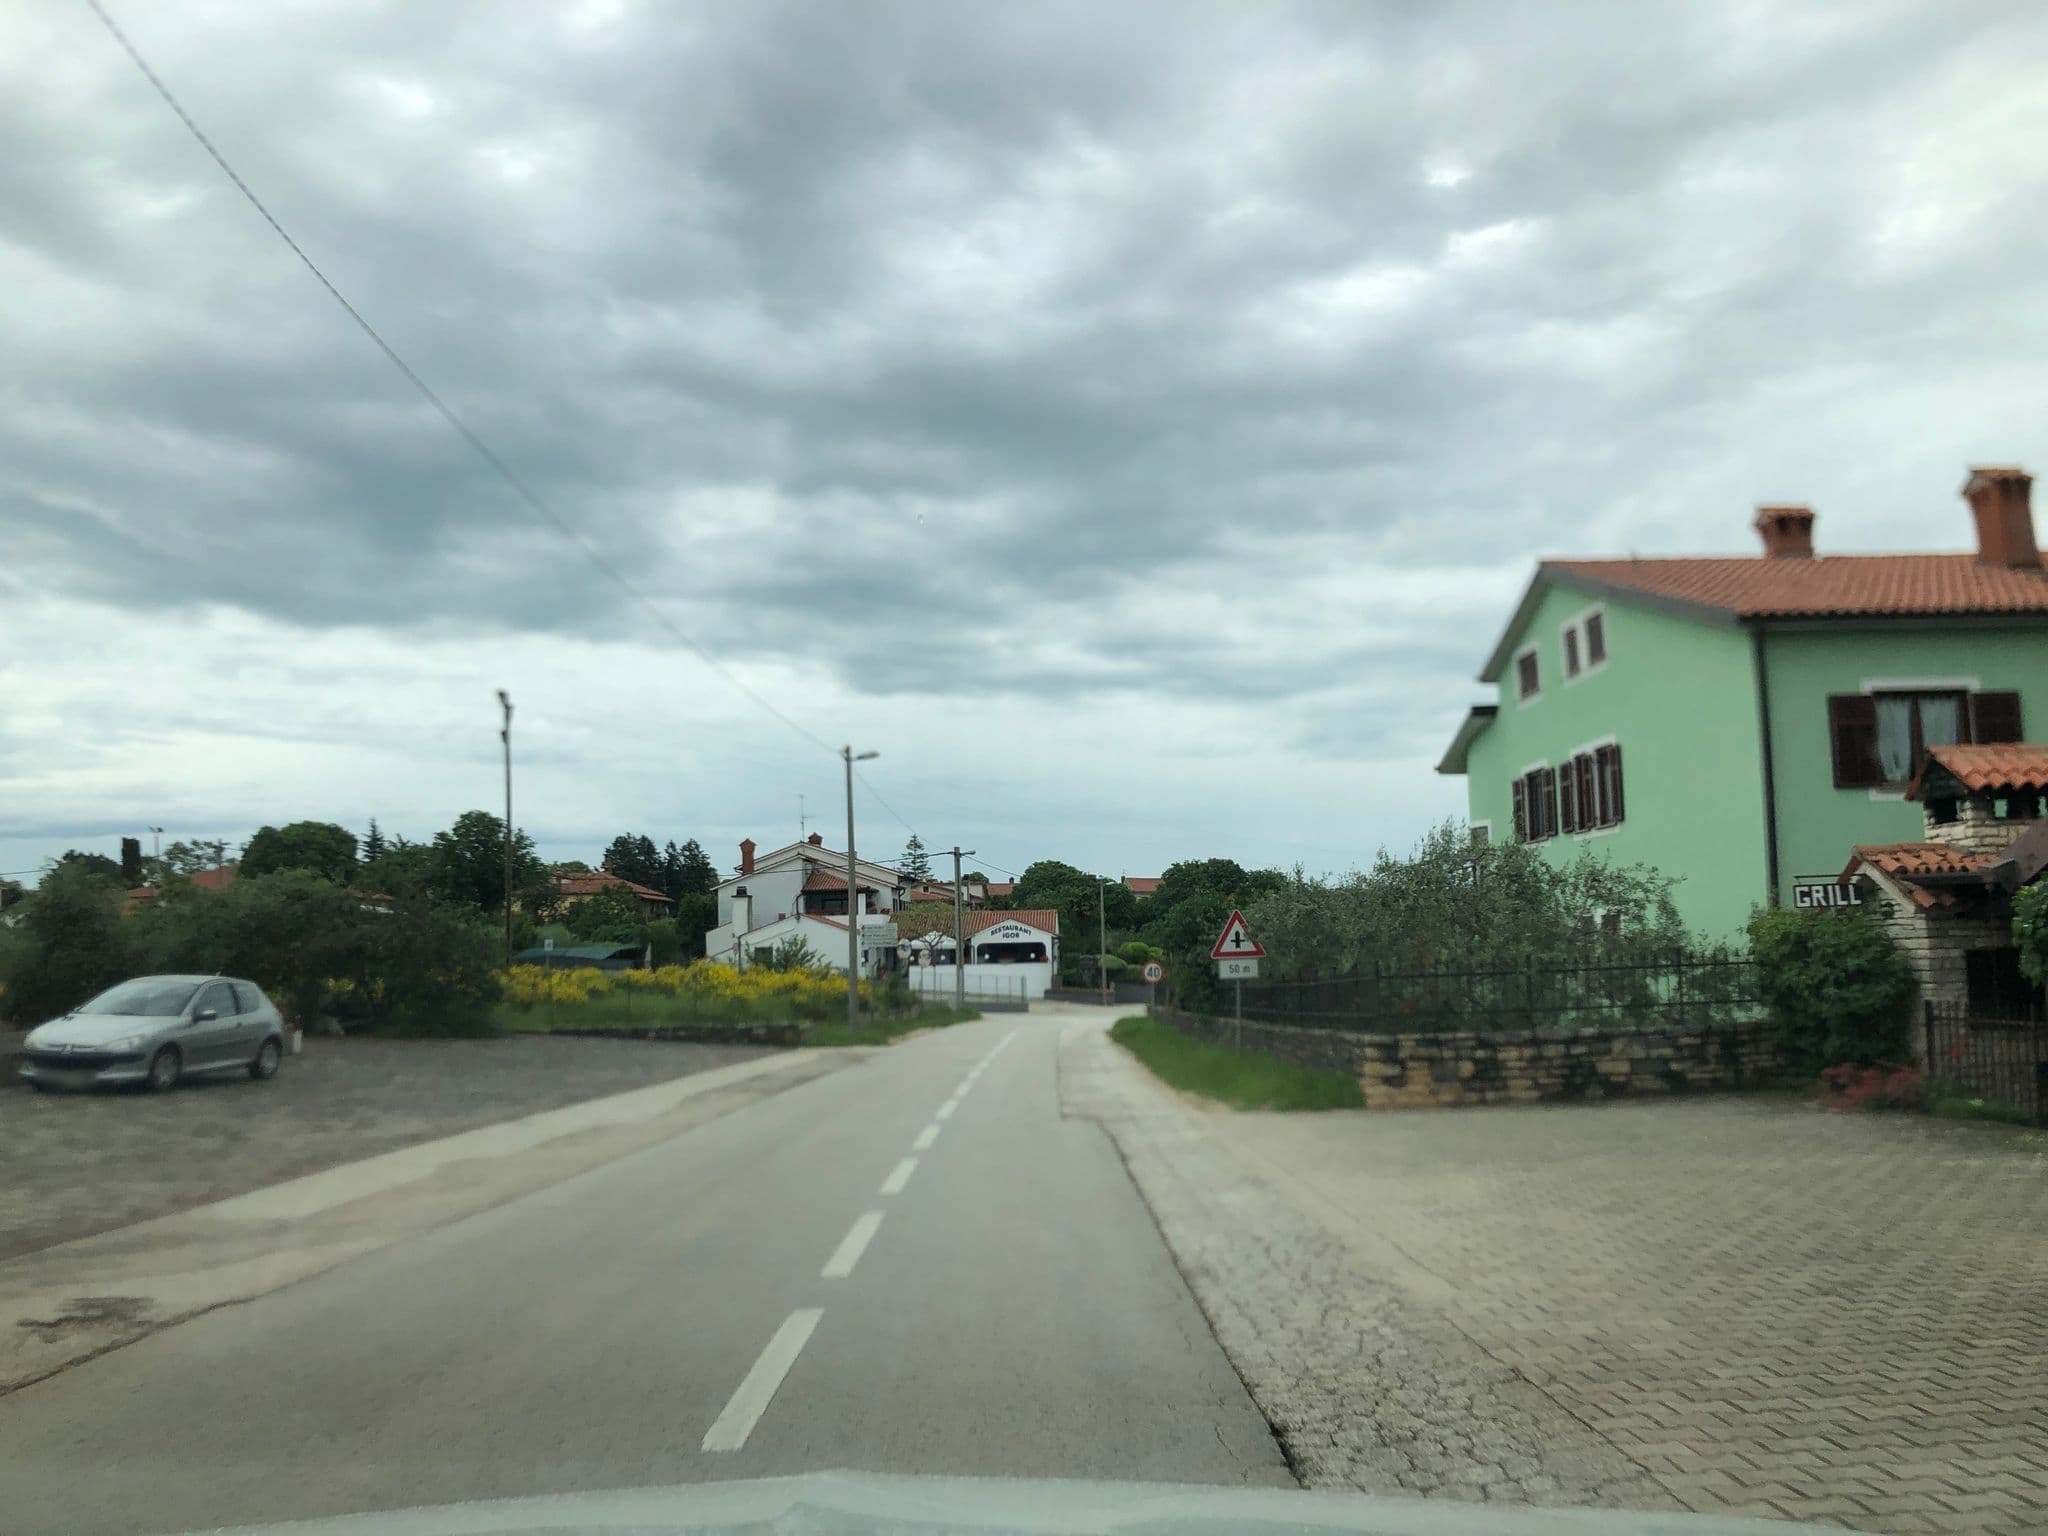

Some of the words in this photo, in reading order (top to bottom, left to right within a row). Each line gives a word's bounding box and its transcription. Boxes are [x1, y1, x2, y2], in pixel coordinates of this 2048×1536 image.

[1795, 885, 1862, 907] GRILL
[990, 924, 1032, 936] RESTAURANT
[1147, 966, 1160, 978] 40
[1229, 964, 1241, 973] 50
[1243, 965, 1251, 973] m
